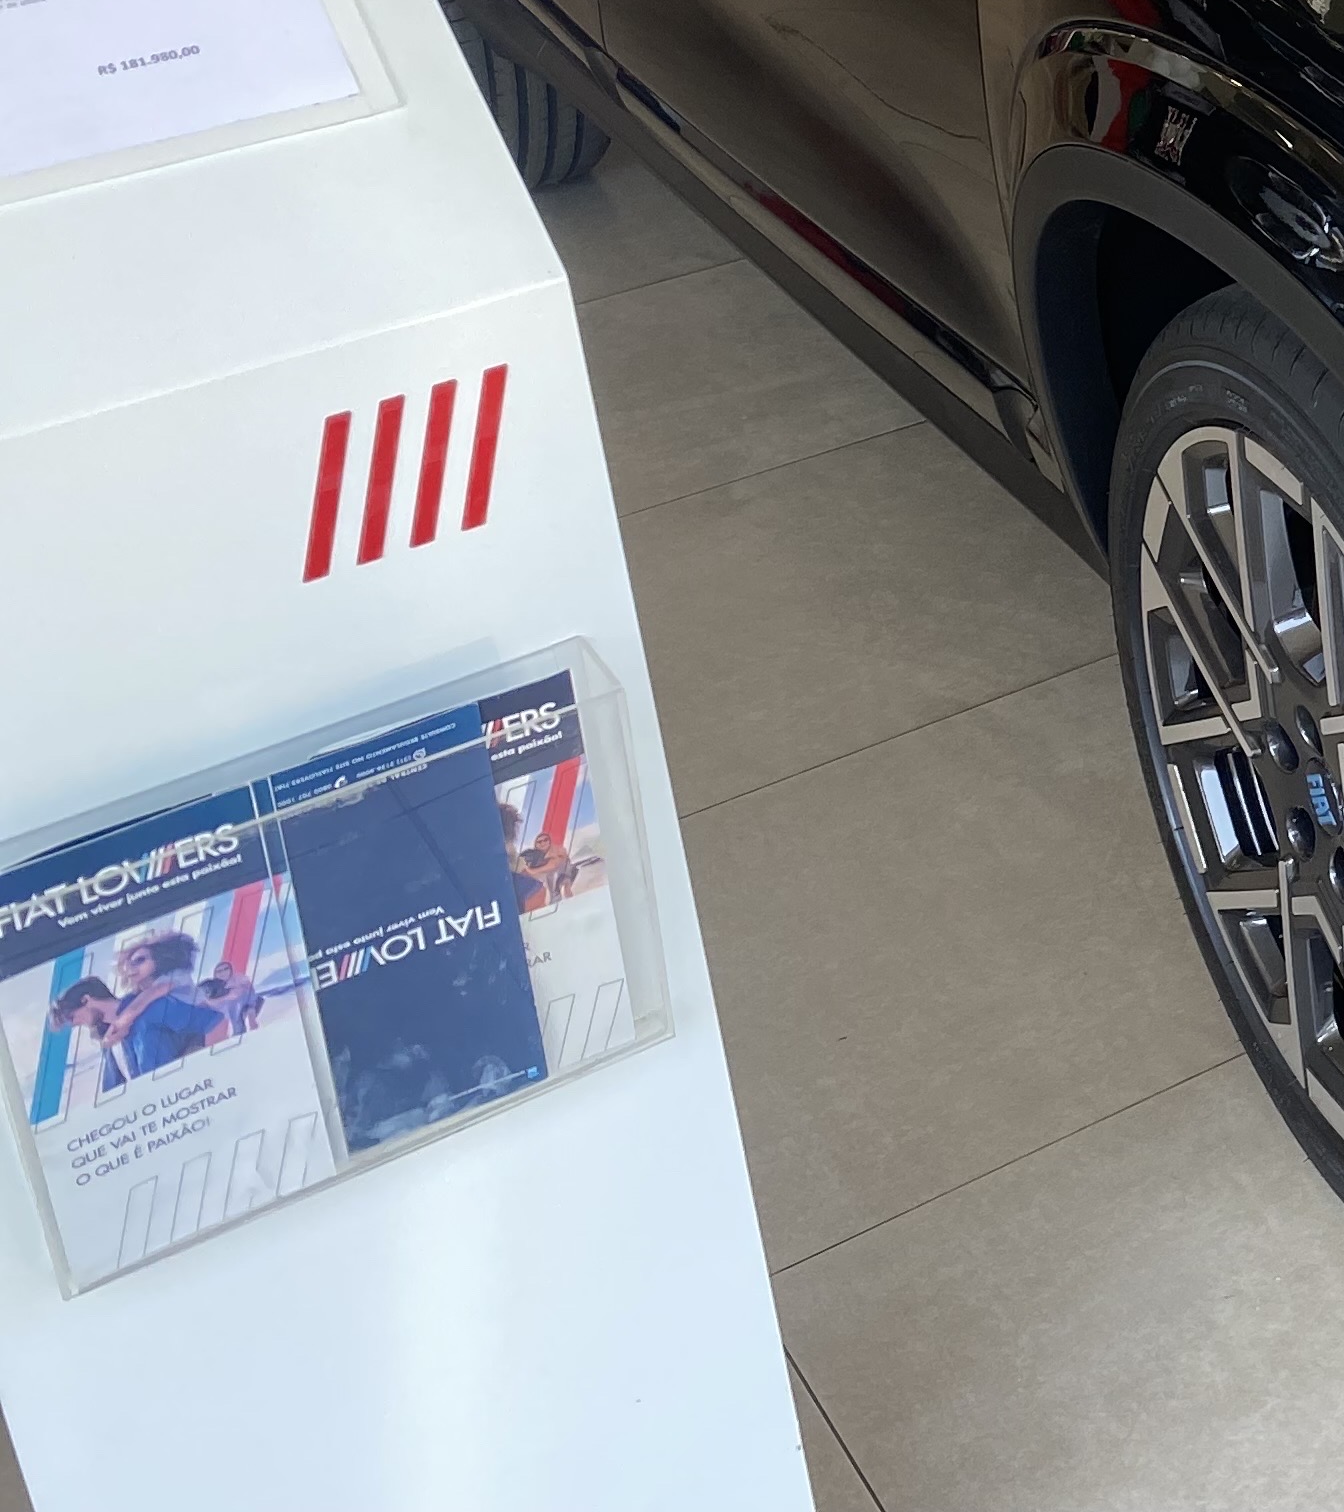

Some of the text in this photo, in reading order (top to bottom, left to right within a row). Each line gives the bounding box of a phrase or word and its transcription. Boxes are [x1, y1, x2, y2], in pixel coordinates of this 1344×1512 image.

[97, 62, 117, 76] R$
[1306, 773, 1337, 826] FIAT
[0, 883, 67, 938] FIAT
[57, 911, 88, 928] Vem
[90, 897, 123, 915] viver
[126, 884, 159, 905] junto
[162, 873, 189, 889] esta
[434, 900, 501, 945] FIAT
[67, 1078, 214, 1153] CHEGOU O LUGAR
[71, 1087, 238, 1169] QUE VAI TE MOSTRAR
[76, 1172, 91, 1186] O
[95, 1153, 130, 1177] QUE
[134, 1143, 145, 1159] É
